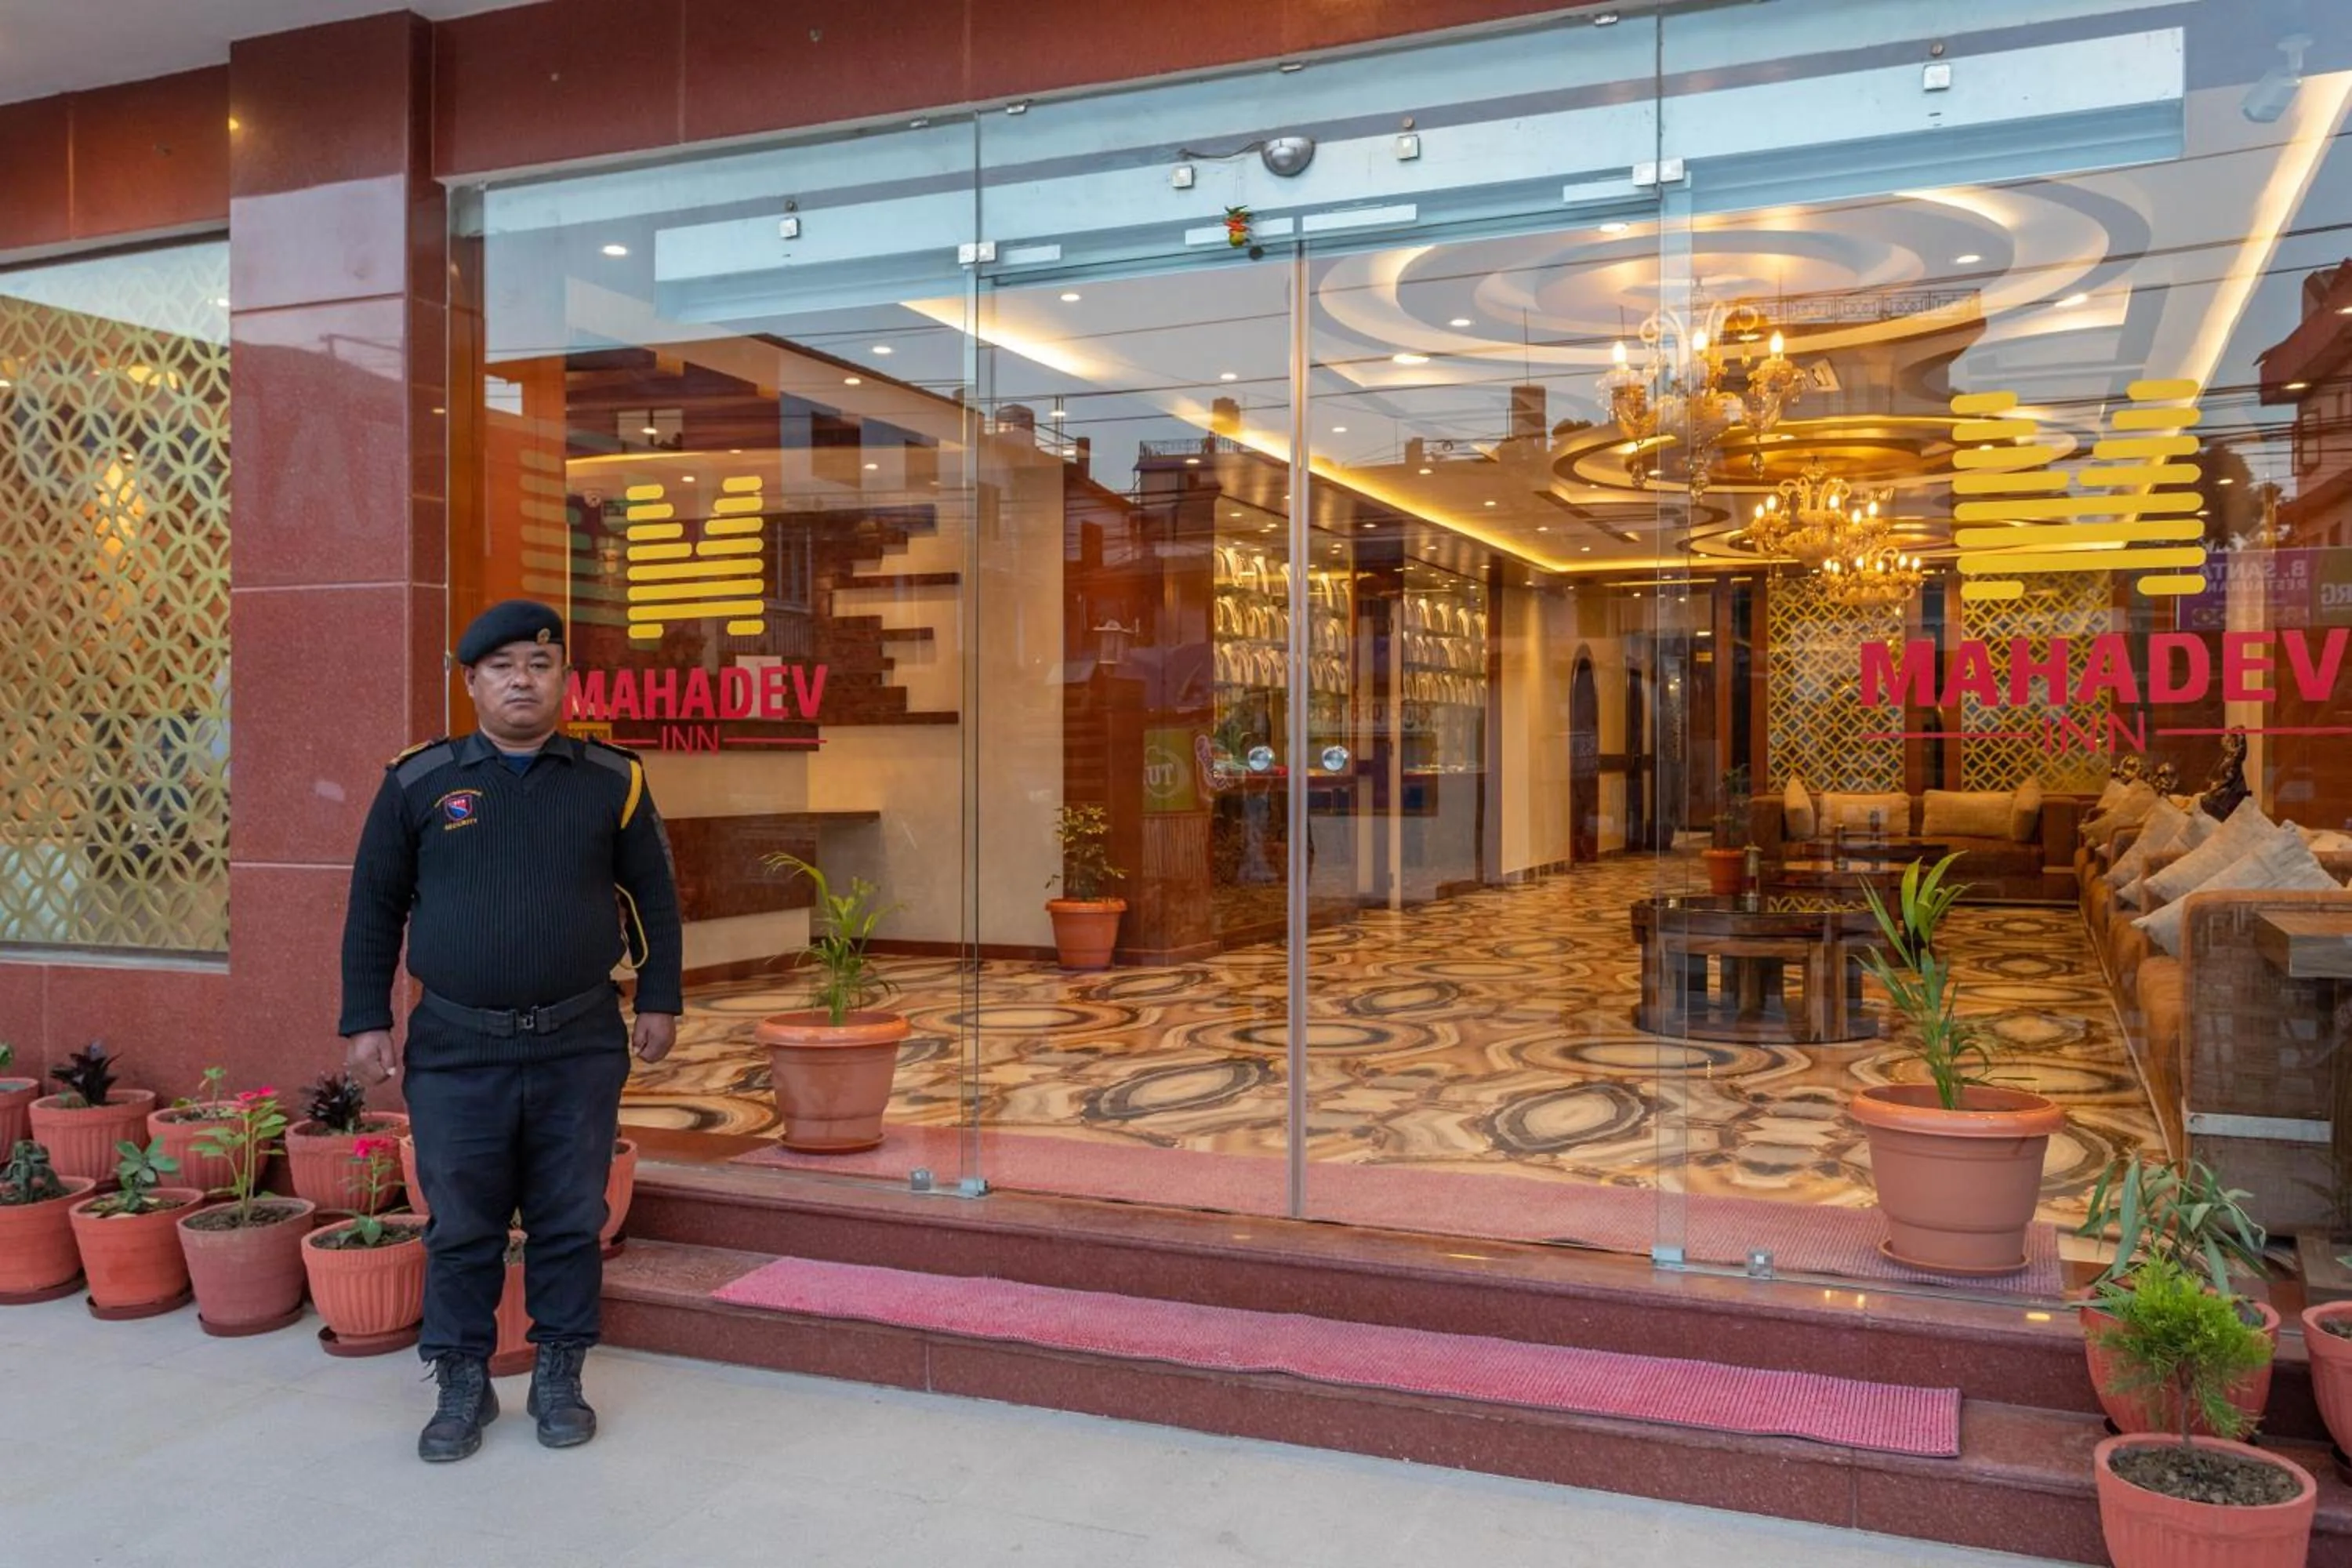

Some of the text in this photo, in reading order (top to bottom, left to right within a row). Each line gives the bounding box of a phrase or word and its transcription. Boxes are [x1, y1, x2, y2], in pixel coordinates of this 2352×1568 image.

[562, 664, 828, 720] MAHADEV
[1860, 629, 2350, 706] MAHADEV
[661, 724, 720, 756] INN
[2044, 711, 2147, 754] INN
